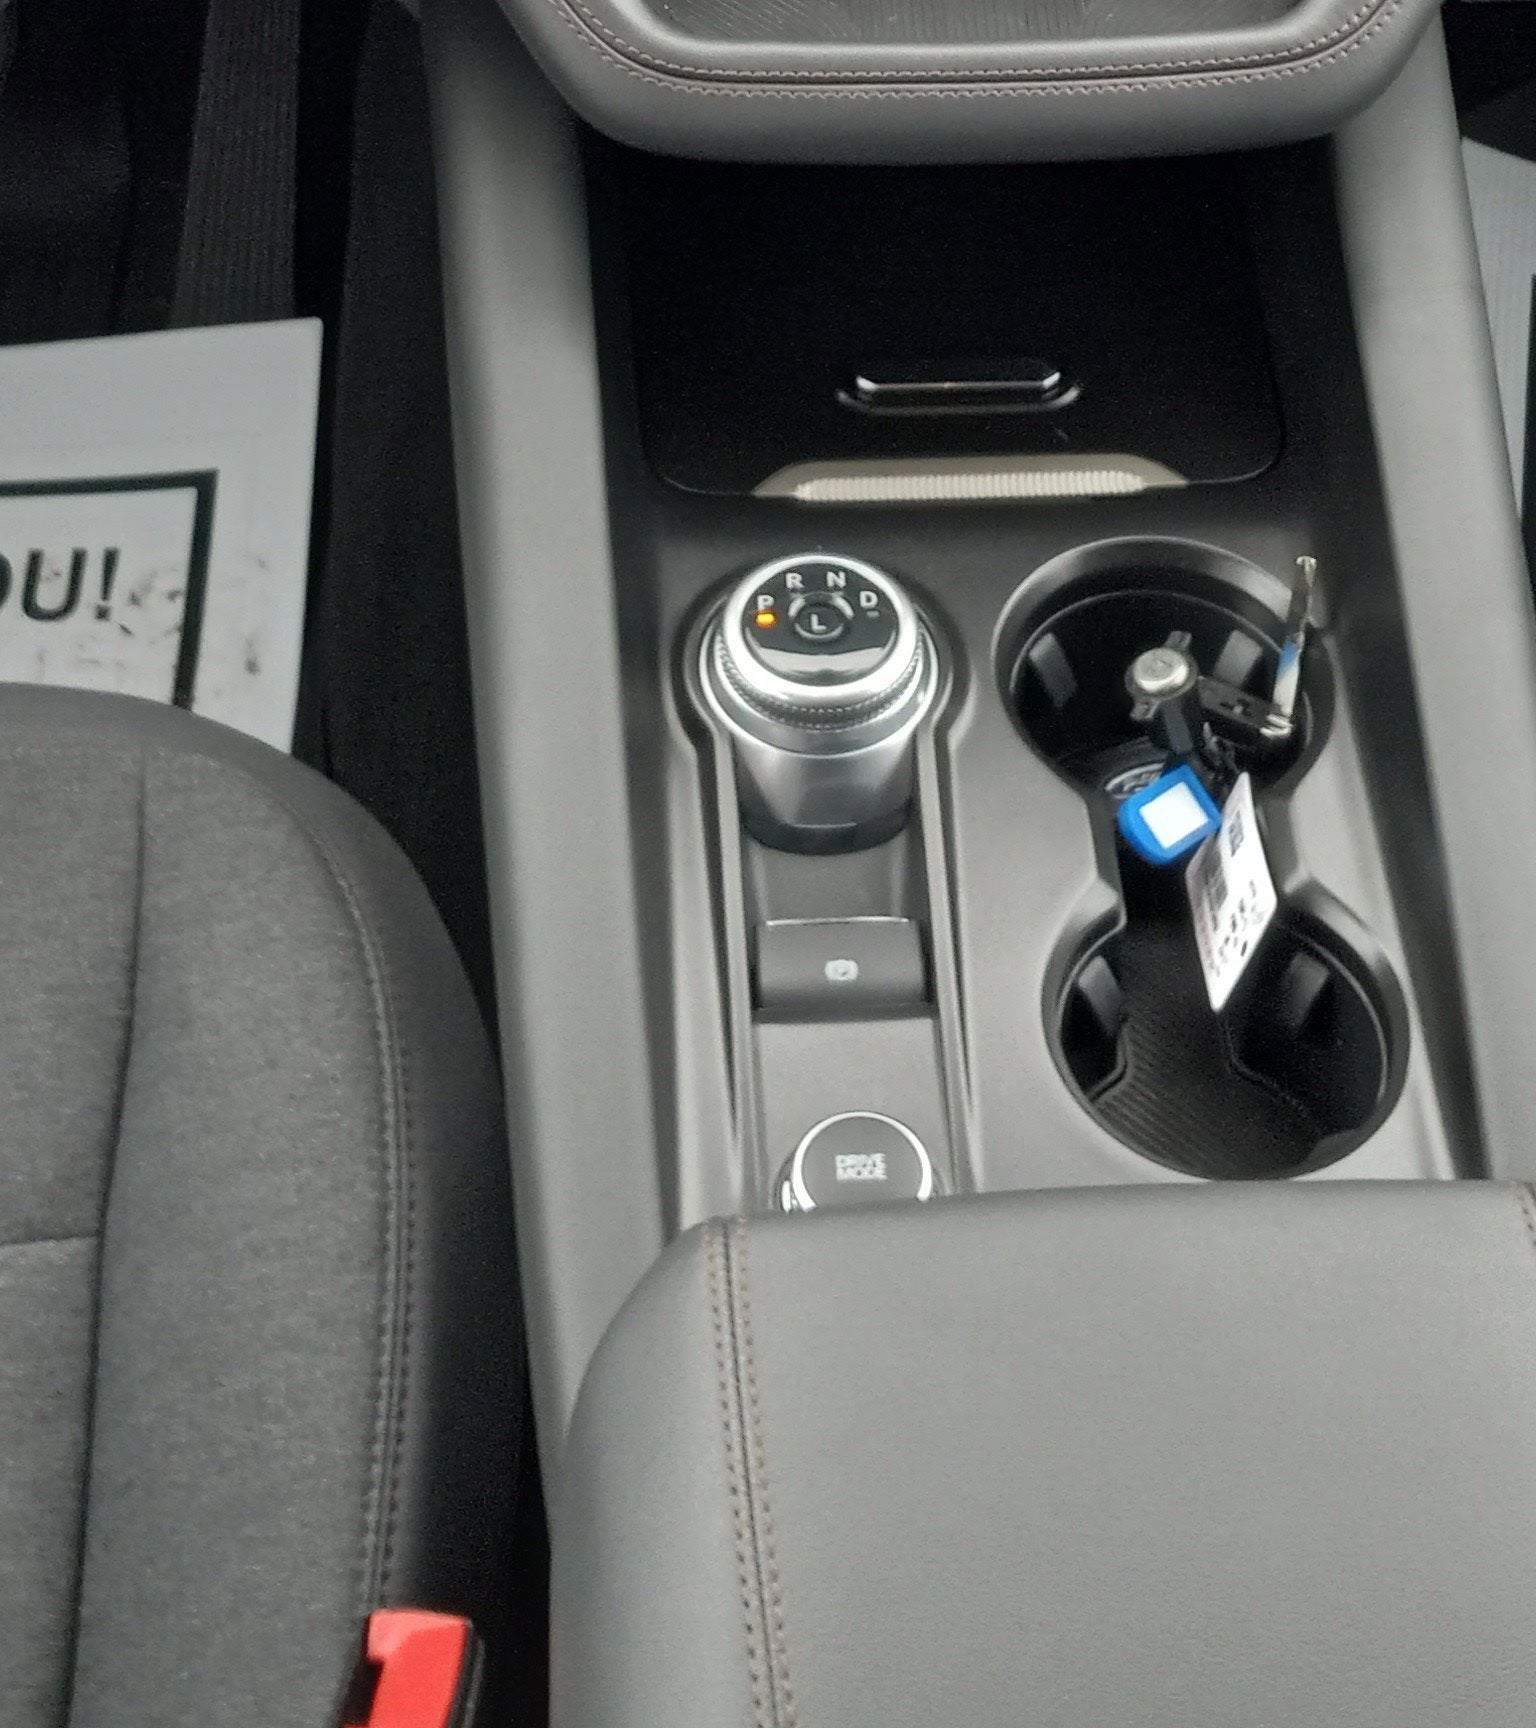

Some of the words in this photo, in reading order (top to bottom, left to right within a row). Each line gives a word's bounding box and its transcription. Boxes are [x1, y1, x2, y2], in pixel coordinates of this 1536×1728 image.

[757, 594, 774, 611] P
[785, 572, 804, 589] R
[826, 571, 846, 589] N
[859, 590, 879, 608] D
[810, 613, 827, 631] L
